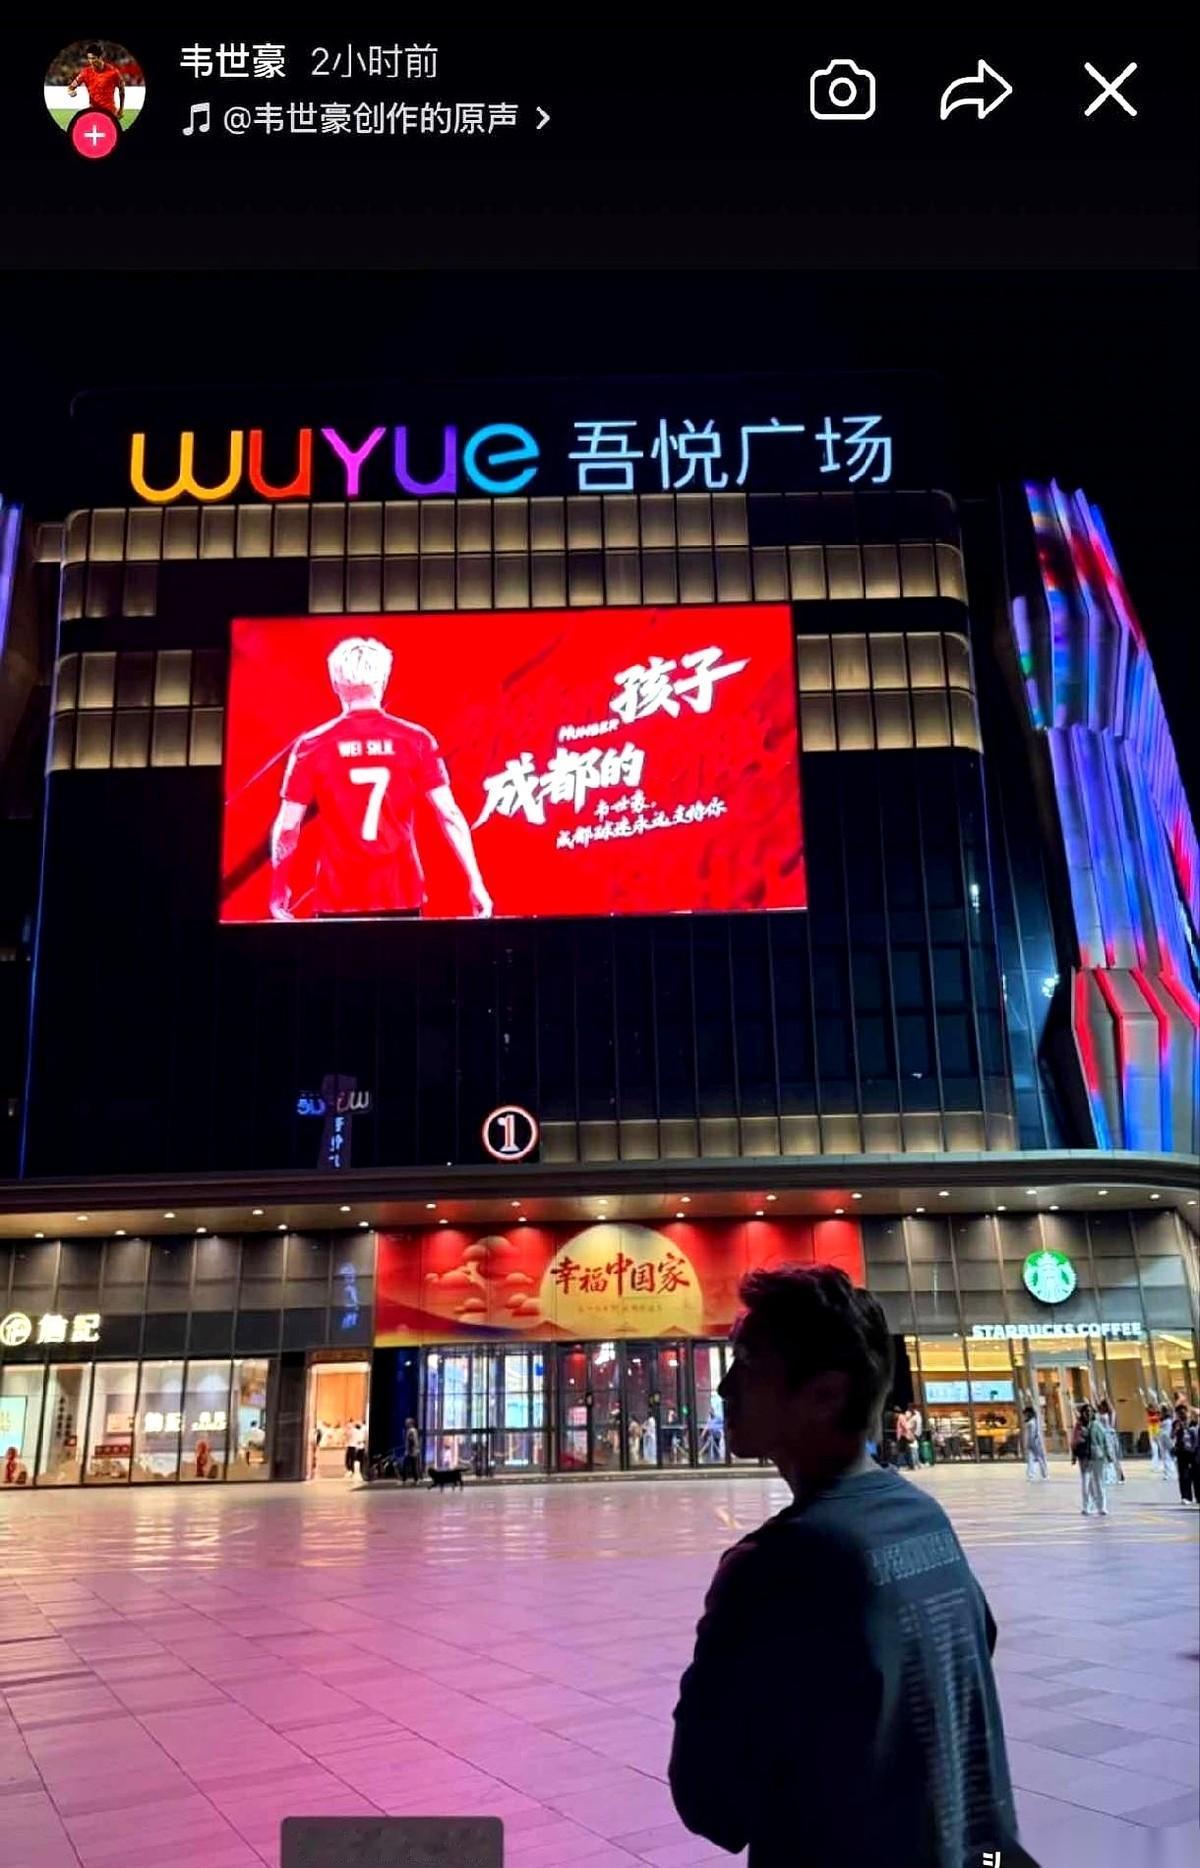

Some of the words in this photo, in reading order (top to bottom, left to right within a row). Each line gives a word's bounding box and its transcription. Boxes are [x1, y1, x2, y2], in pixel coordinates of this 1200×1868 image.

[568, 415, 893, 492] 吾悦广场
[610, 646, 751, 723] 孩子
[350, 766, 391, 841] 7
[470, 742, 646, 826] 成都的
[551, 1252, 690, 1297] 幸福中国家
[972, 1323, 1075, 1339] STARBUCKS
[1078, 1322, 1142, 1337] COFFEE
